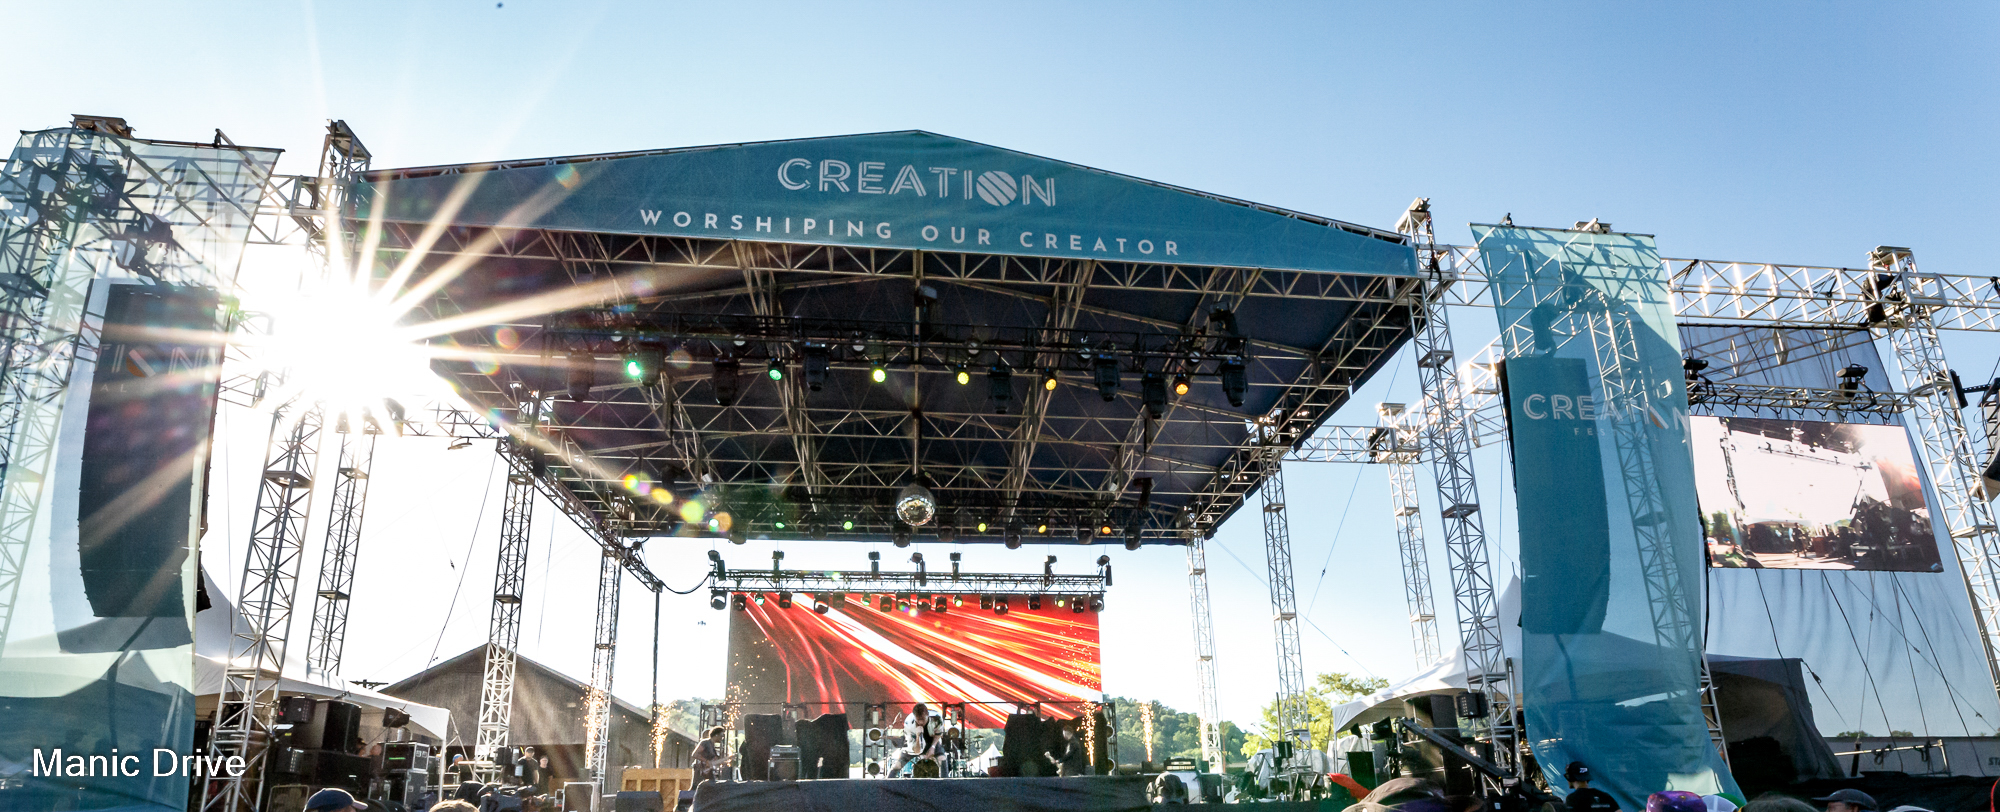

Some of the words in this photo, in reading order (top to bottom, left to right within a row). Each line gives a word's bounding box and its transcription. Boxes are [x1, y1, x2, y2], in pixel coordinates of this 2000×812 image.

[777, 157, 1056, 207] CREATION
[640, 209, 892, 239] WORSHIPING
[921, 225, 991, 246] OUR
[1020, 231, 1179, 256] CREATOR
